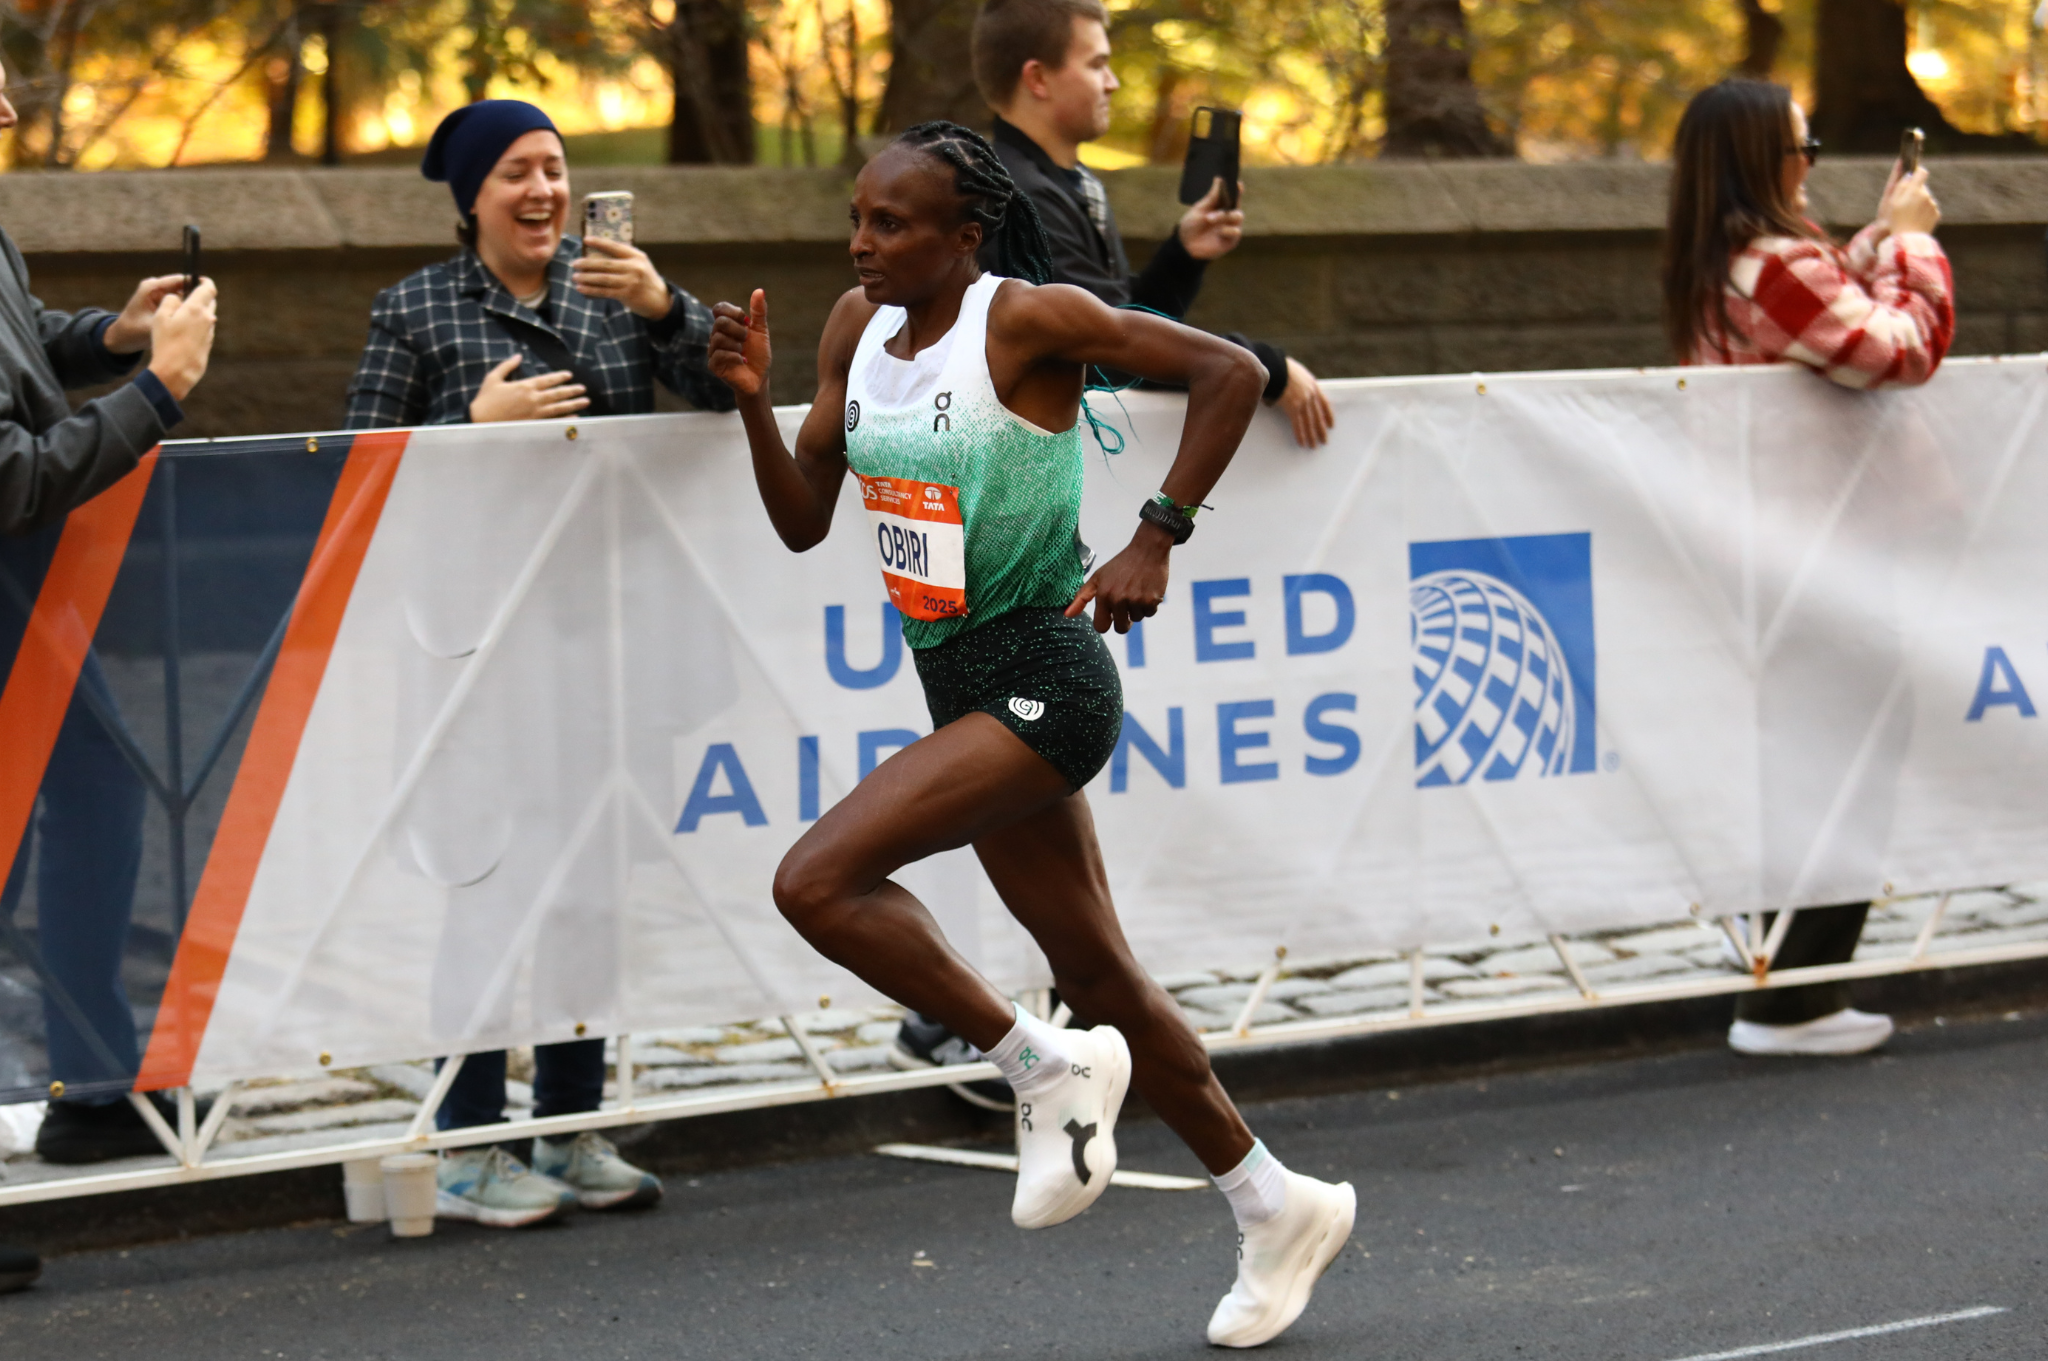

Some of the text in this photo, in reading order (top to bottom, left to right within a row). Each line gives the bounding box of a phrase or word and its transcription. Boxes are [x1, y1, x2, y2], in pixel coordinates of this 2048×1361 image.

[922, 501, 945, 511] TATA
[877, 522, 929, 578] OBIRI
[923, 595, 958, 614] 2025
[823, 572, 1356, 690] UED
